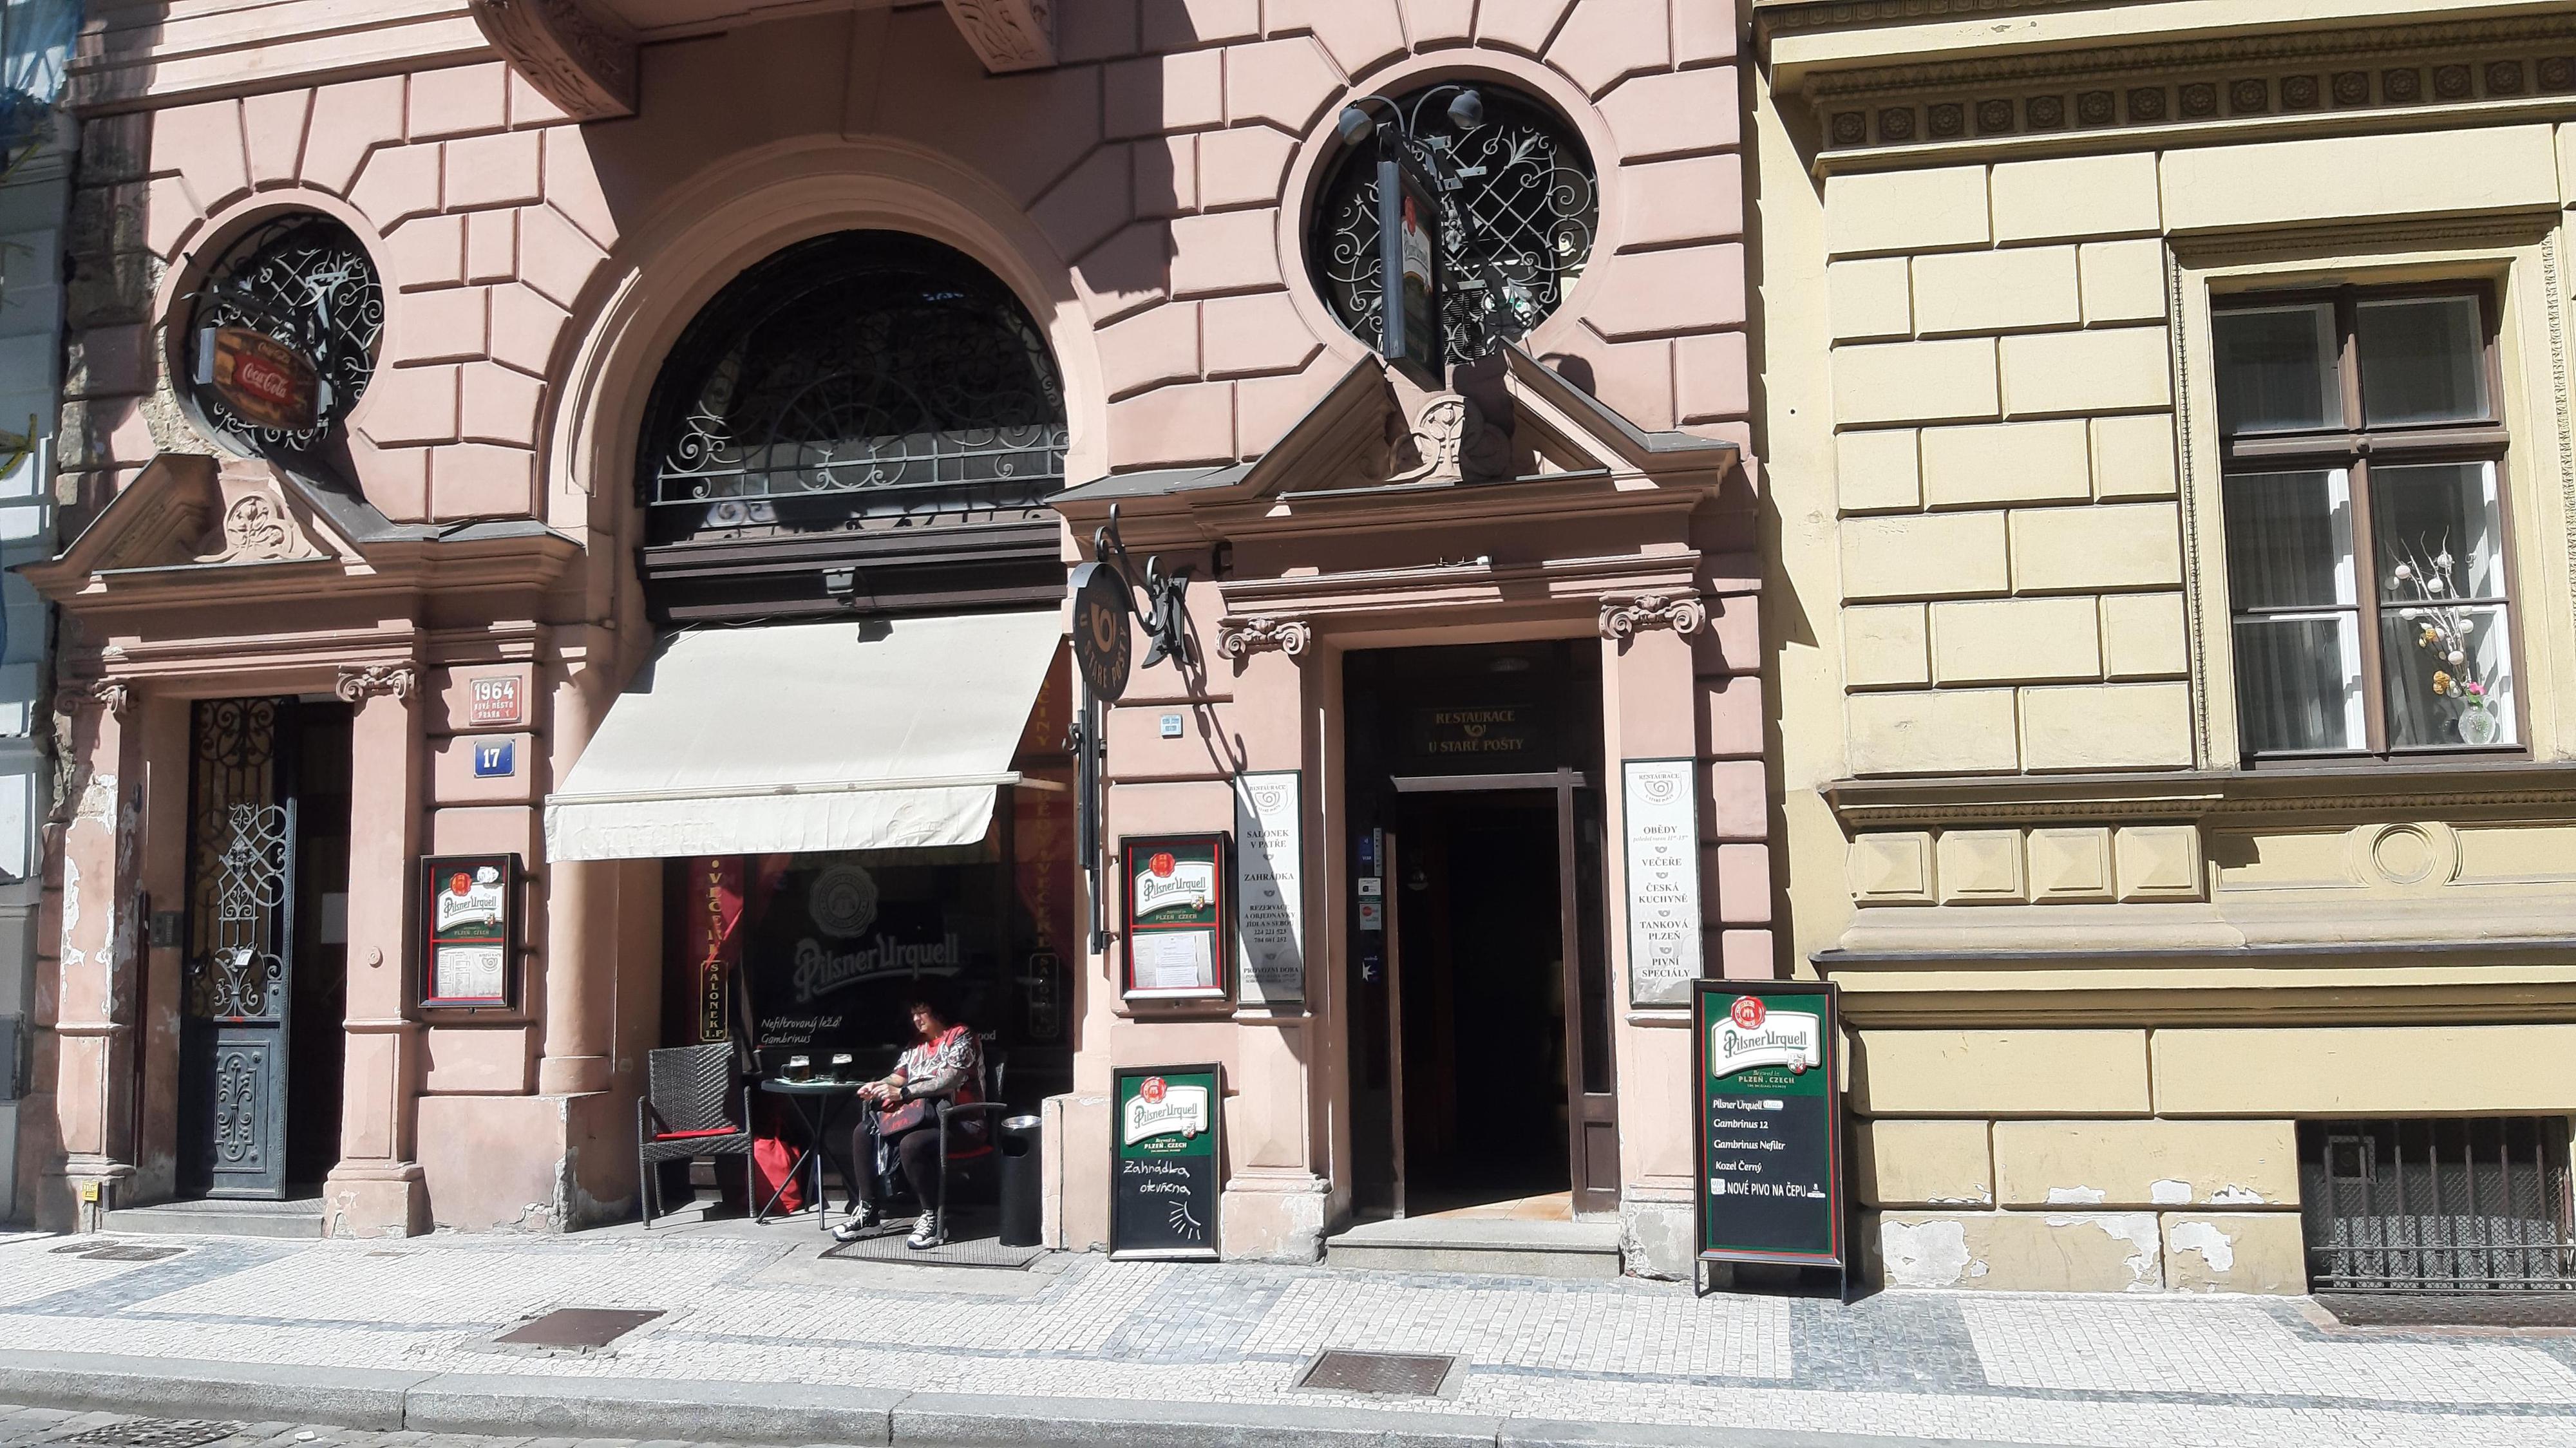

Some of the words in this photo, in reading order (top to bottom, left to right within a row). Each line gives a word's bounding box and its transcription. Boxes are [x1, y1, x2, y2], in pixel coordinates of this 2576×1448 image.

[474, 681, 515, 701] 1964
[1435, 710, 1515, 724] RESTAURACE
[1428, 740, 1437, 753] U
[483, 748, 500, 768] 17
[1247, 830, 1289, 838] SALONEK
[1643, 824, 1678, 834] OBĚDY
[1258, 838, 1287, 849] PATŘE
[1642, 856, 1682, 866] VEČEŘE
[1244, 871, 1294, 881] ZAHRÁDKA
[1144, 878, 1175, 902] Pilsner
[1175, 876, 1206, 893] Urquell
[1645, 881, 1679, 892] ČESKÁ
[1638, 893, 1688, 903] KUCHYNĚ
[444, 897, 470, 919] Pilsner
[471, 895, 497, 912] Urquell
[1640, 918, 1689, 928] TANKOVÁ
[1649, 930, 1680, 941] PLZEŇ
[1652, 955, 1679, 966] PIVNÍ
[793, 937, 878, 1004] Pilsner
[878, 932, 960, 980] Urquell
[1642, 967, 1690, 977] SPECIÁLY
[708, 964, 720, 1028] SALONEK
[761, 1016, 818, 1034] Nefiltrovaný
[761, 1032, 811, 1045] Gambrinus
[1723, 1029, 1766, 1059] Pilsner
[1766, 1029, 1806, 1051] Urquell
[1713, 1099, 1736, 1110] Pilsner
[1737, 1100, 1763, 1112] Urquell
[1134, 1105, 1166, 1129] Pilsner
[1166, 1103, 1198, 1120] Urquell
[1713, 1118, 1758, 1129] Gambrinus
[1759, 1120, 1769, 1129] 12
[1713, 1139, 1759, 1150] Gambrinus
[1759, 1140, 1786, 1152] Nefiltr
[1715, 1160, 1737, 1171] Kozel
[1738, 1160, 1763, 1174] Černý
[1727, 1180, 1749, 1196] NOVÉ
[1750, 1183, 1770, 1196] PIVO
[1772, 1184, 1784, 1197] NA
[1786, 1181, 1806, 1198] ČEPU
